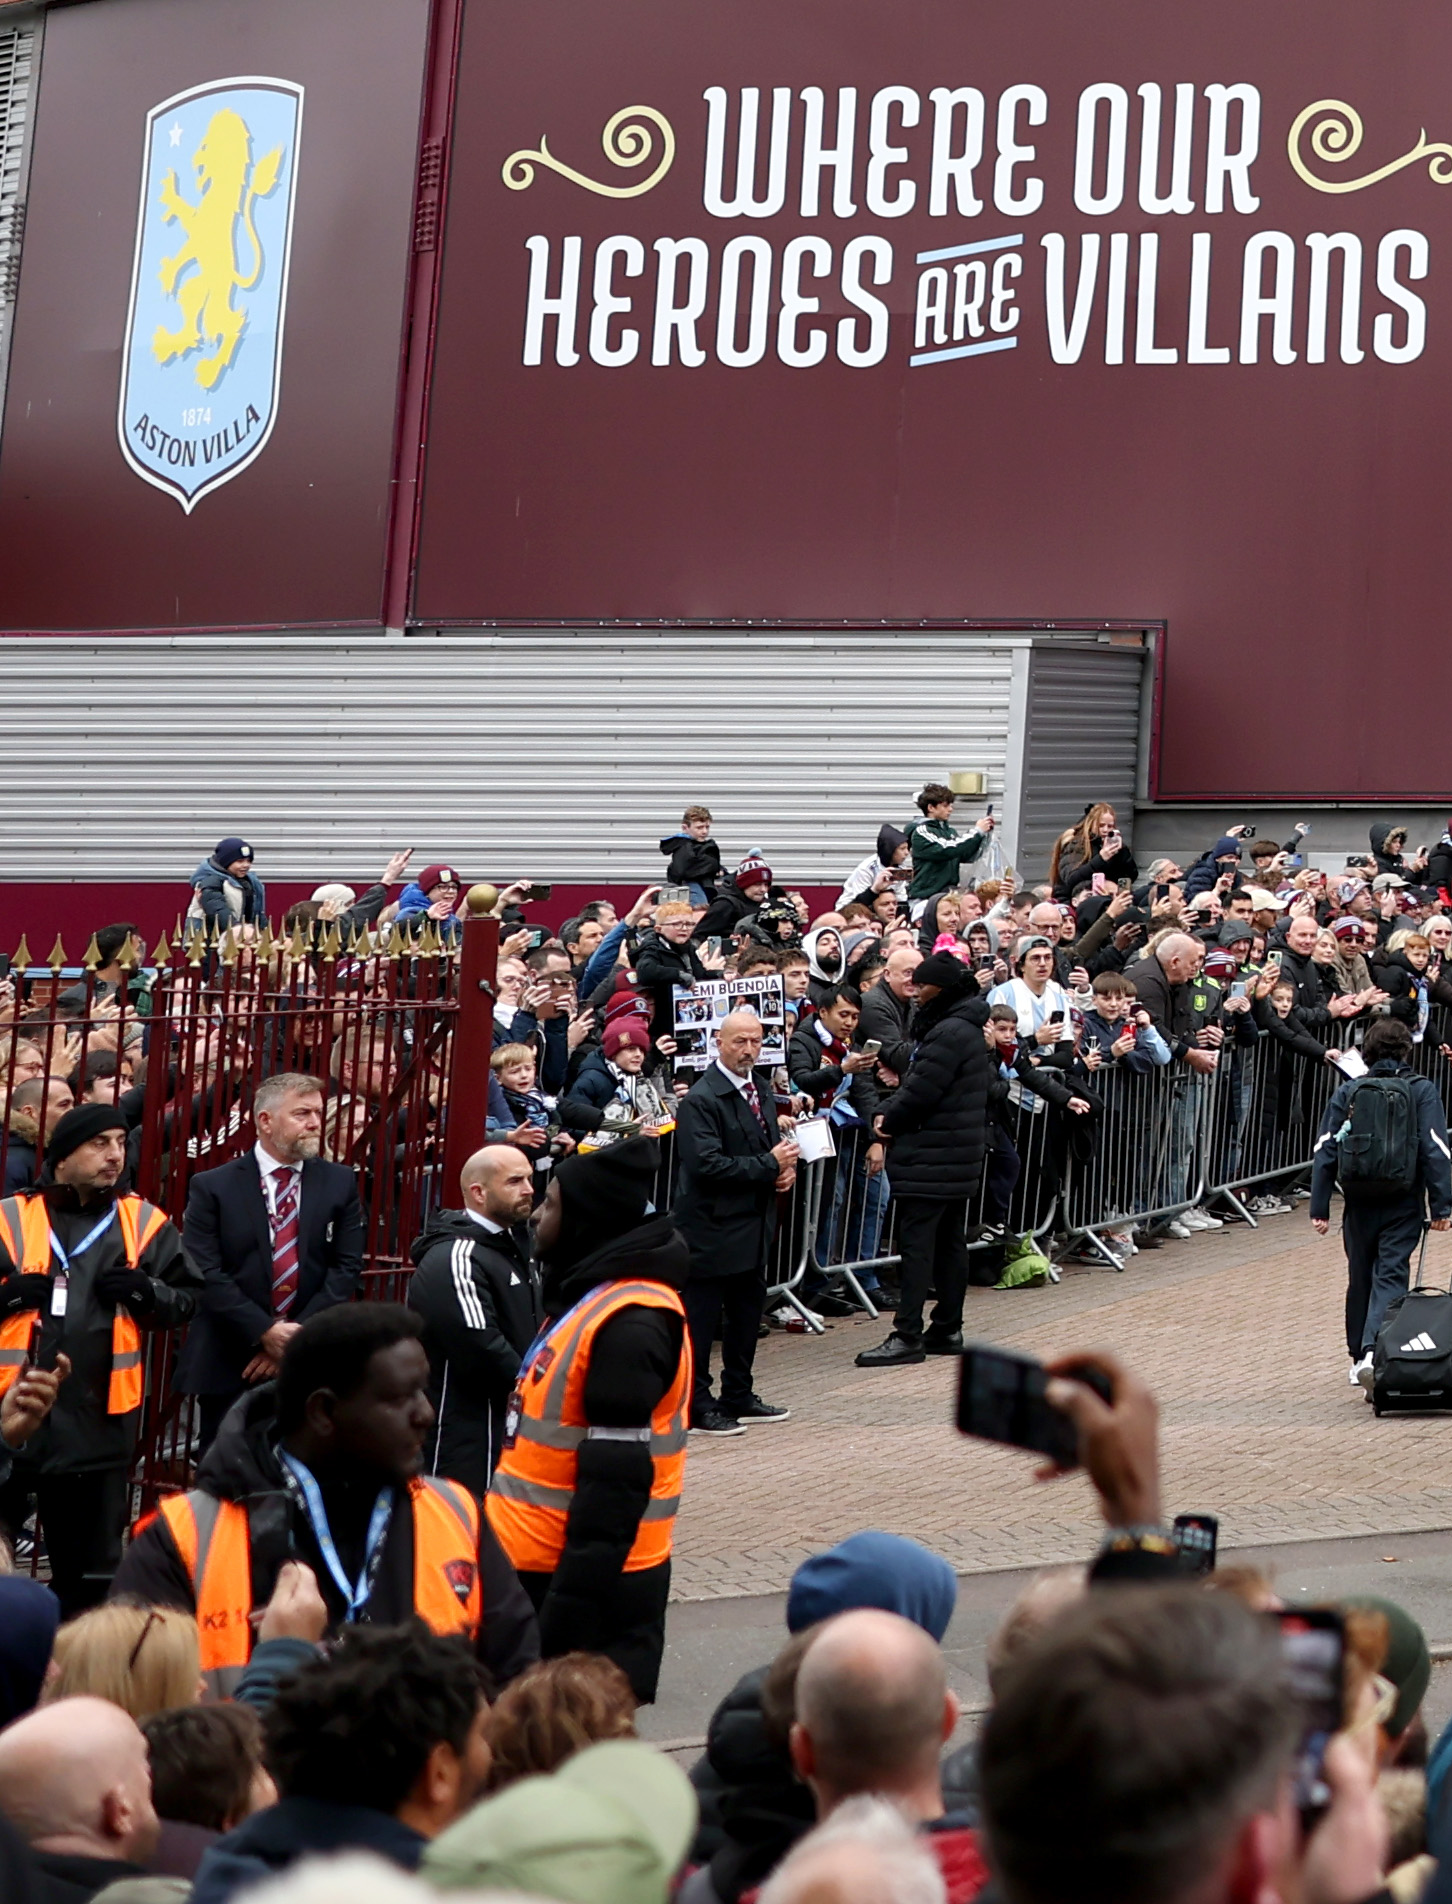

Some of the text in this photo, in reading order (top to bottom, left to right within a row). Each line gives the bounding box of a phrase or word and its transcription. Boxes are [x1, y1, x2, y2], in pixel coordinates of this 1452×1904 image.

[703, 82, 1261, 218] WHERE OUR
[523, 229, 1430, 368] HEROES ARE VILLANS
[133, 403, 261, 467] ASTON VILLA
[181, 407, 212, 426] 1874
[692, 976, 779, 997] EMI BUENDÍA
